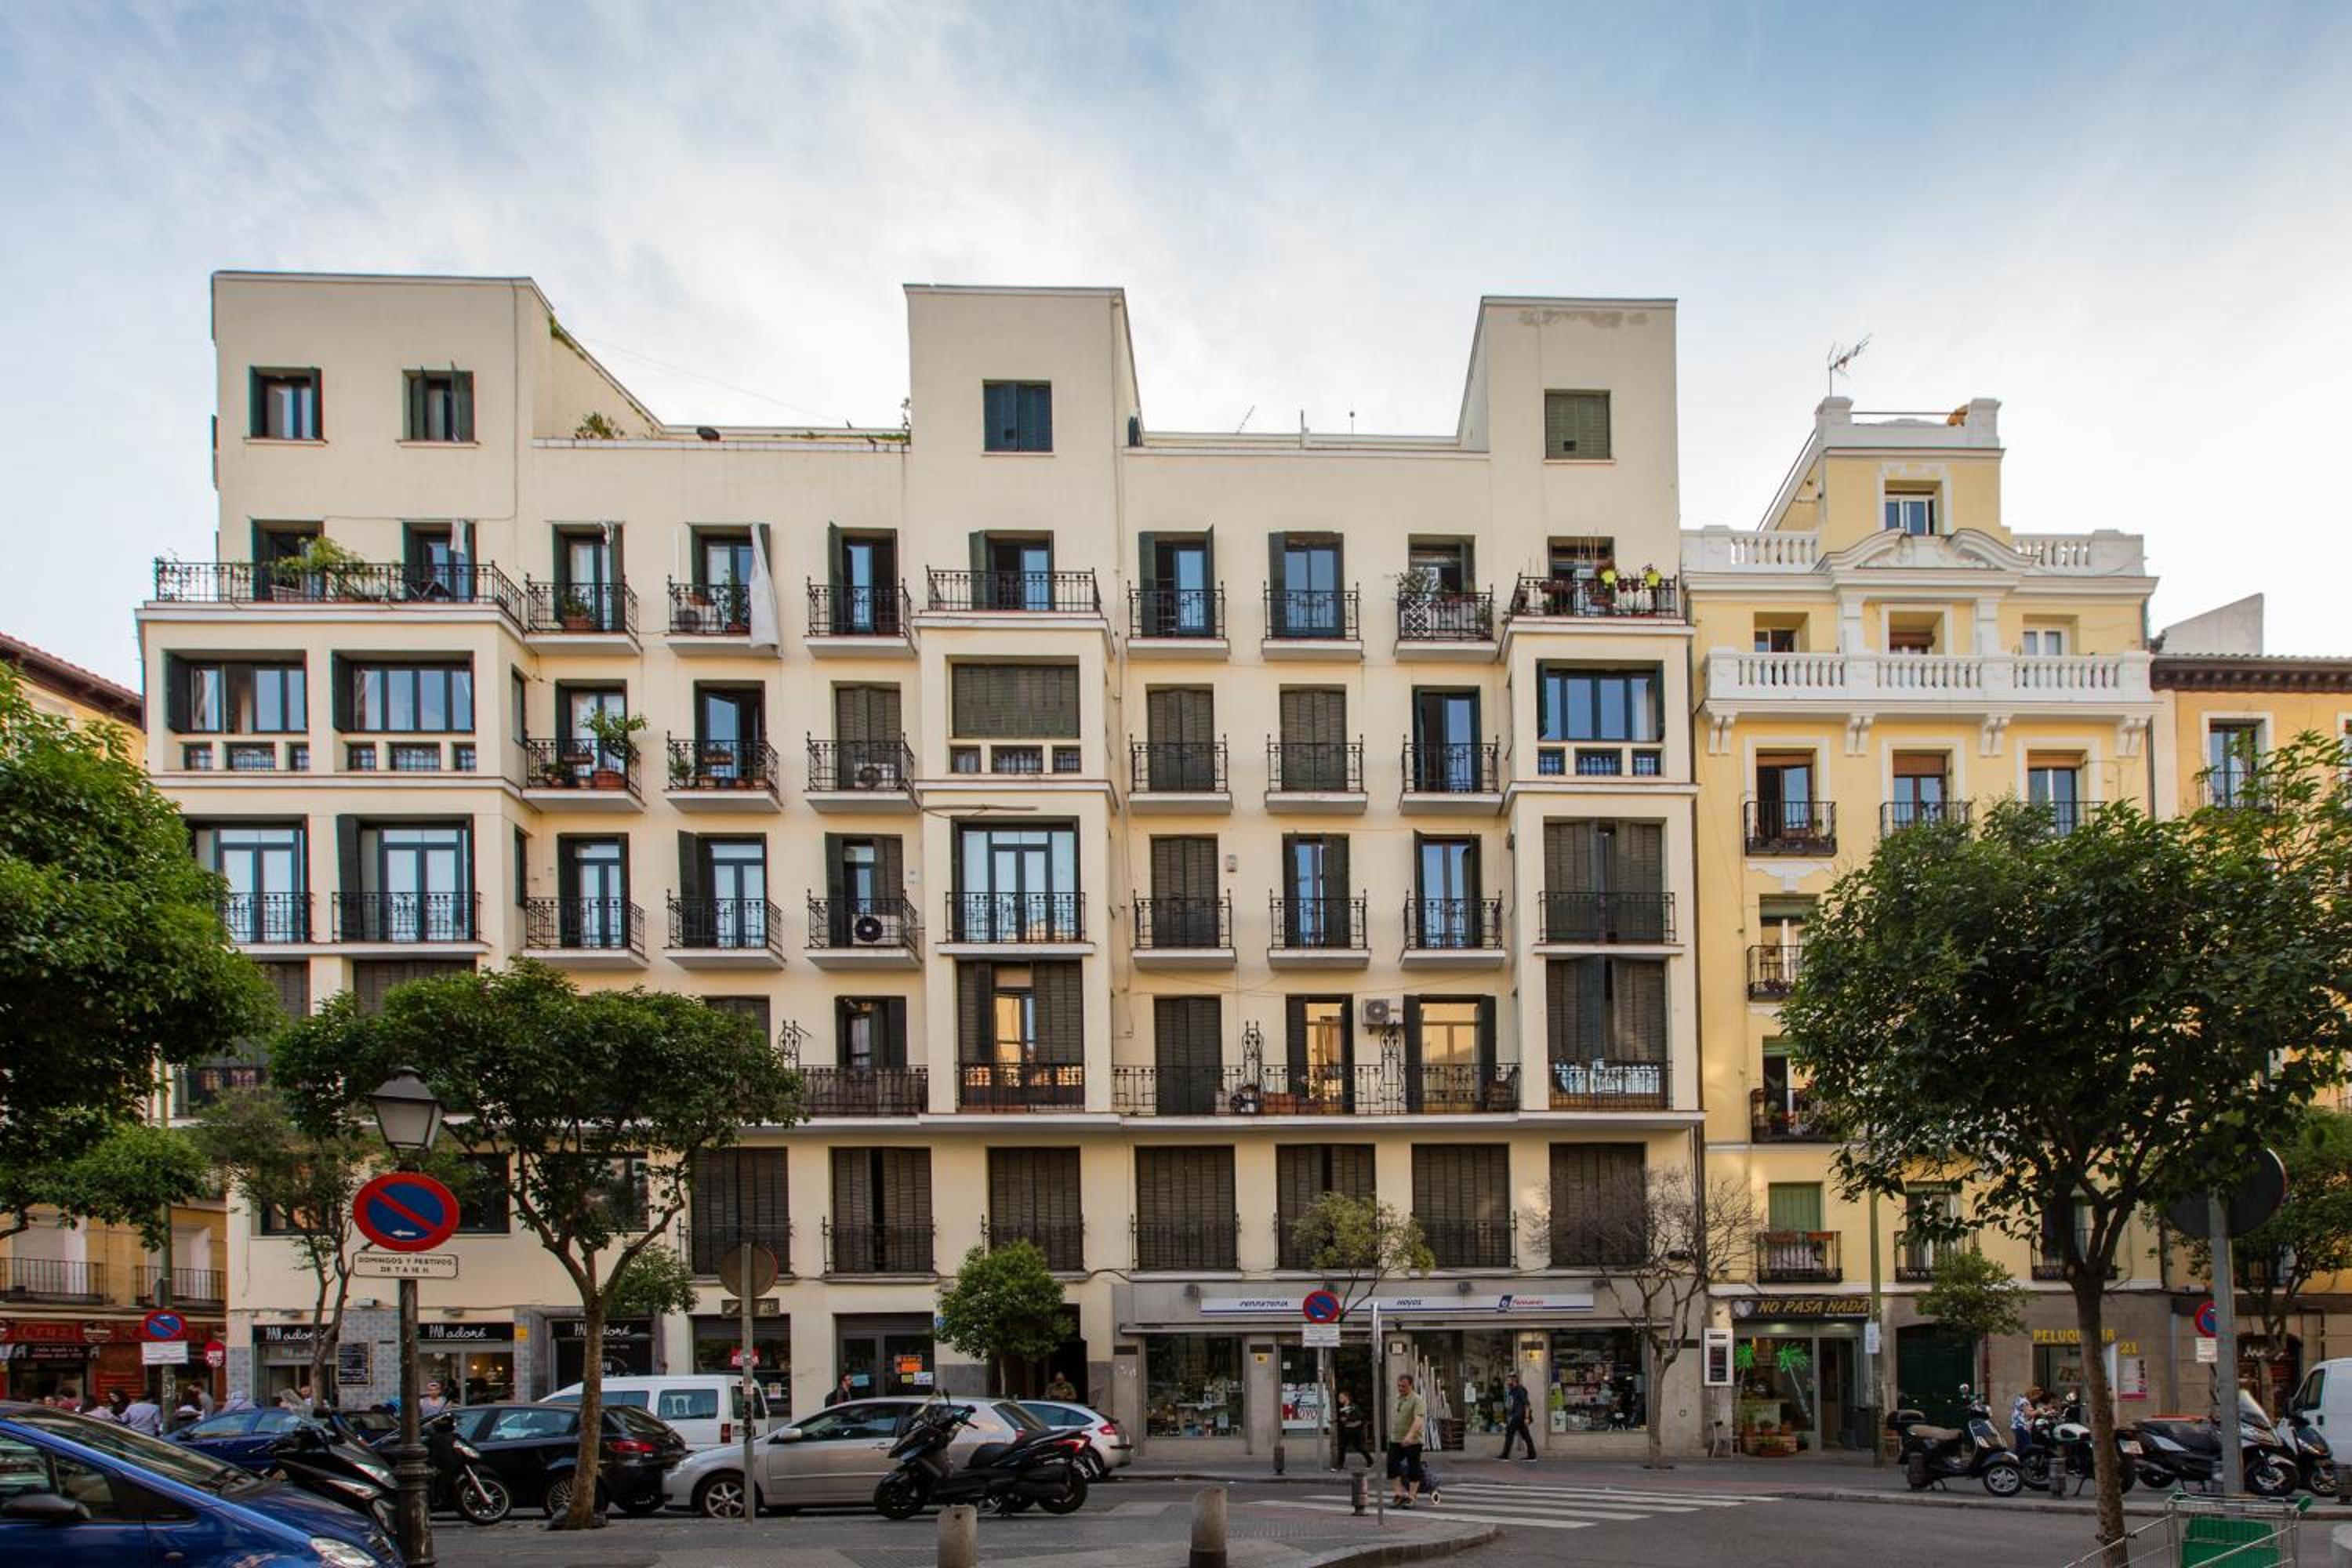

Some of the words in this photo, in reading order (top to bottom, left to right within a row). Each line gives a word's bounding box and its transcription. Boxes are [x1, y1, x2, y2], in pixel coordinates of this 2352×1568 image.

[415, 1258, 452, 1266] FESTIVOS
[1758, 1301, 1780, 1313] NO
[1783, 1301, 1824, 1313] PASA
[1826, 1300, 1867, 1313] NADA
